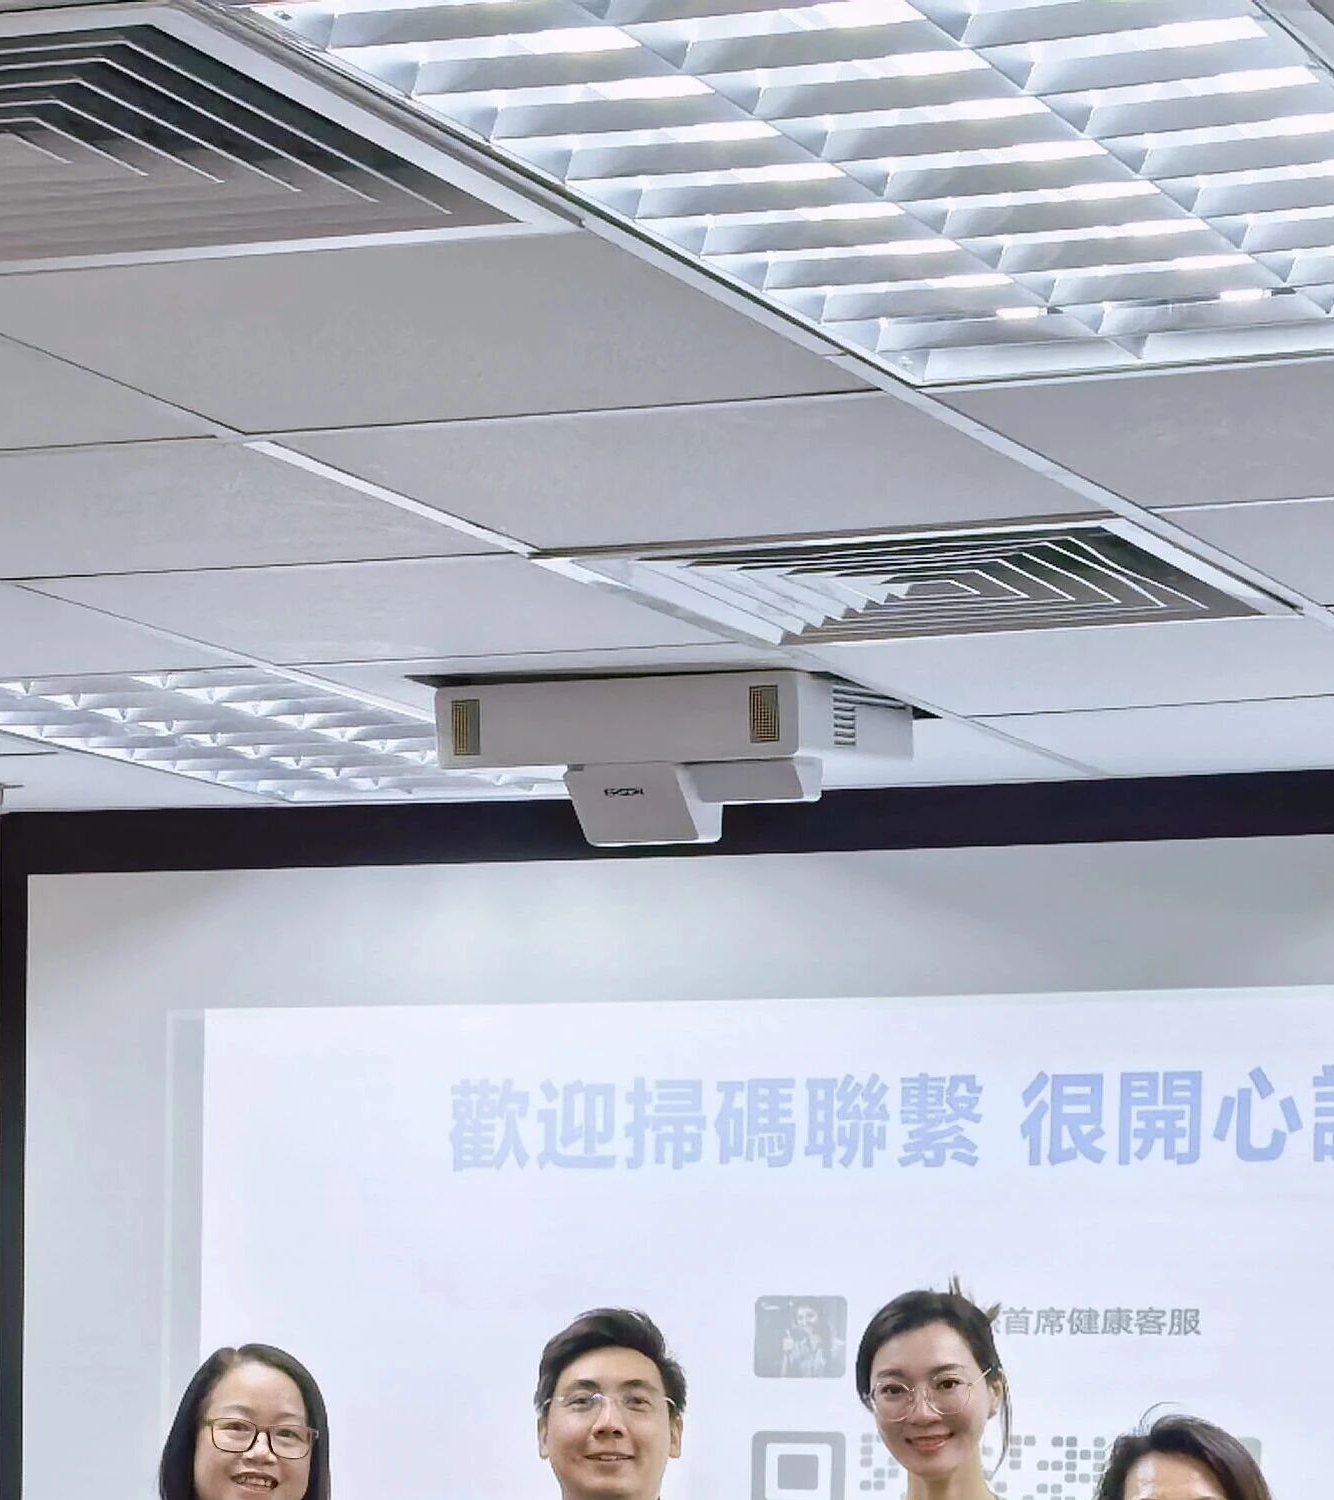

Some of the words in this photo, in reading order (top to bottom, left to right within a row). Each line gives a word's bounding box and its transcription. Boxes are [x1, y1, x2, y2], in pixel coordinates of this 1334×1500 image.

[448, 1073, 985, 1170] 歡迎掃碼聯繫
[993, 1306, 1201, 1336] 首席健康客服
